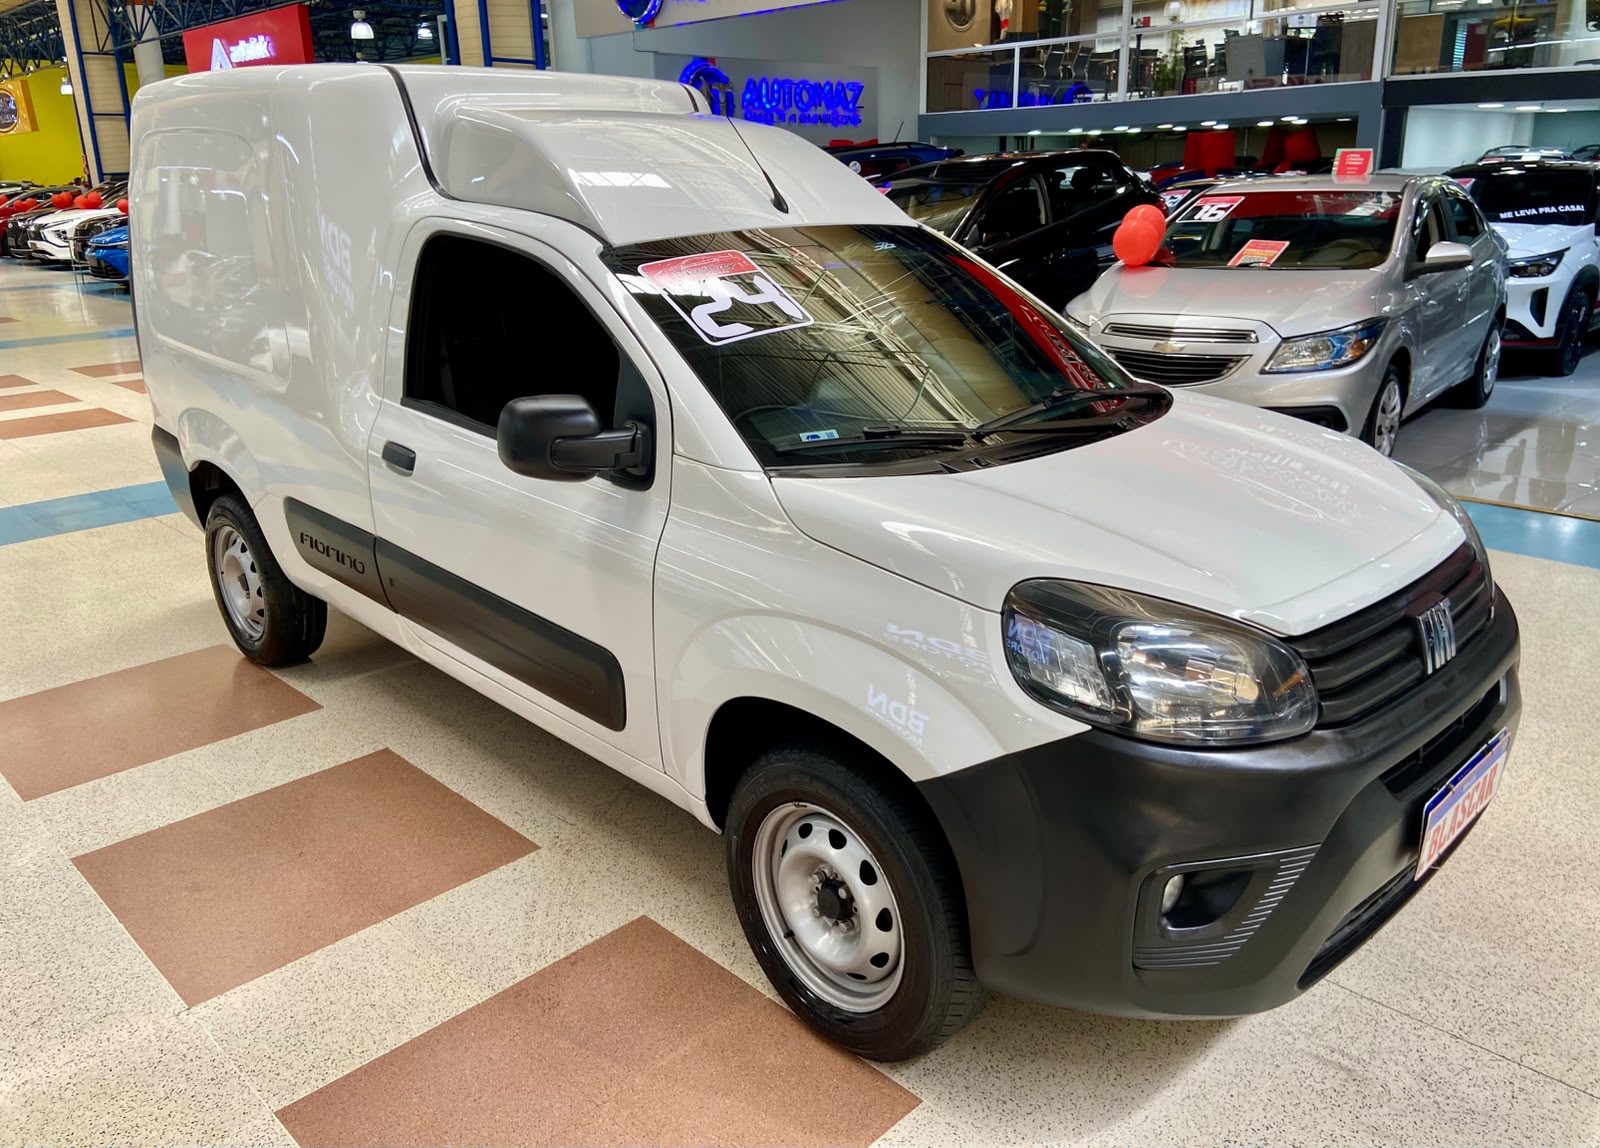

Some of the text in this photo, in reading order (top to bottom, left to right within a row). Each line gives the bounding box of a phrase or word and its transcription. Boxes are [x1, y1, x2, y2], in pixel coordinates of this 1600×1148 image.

[742, 77, 864, 112] AUTOMAZ
[1193, 204, 1231, 220] 16
[1515, 208, 1537, 217] LEVA
[1538, 206, 1555, 214] PRA
[1558, 204, 1585, 212] CASA!
[690, 275, 804, 338] 24
[1427, 764, 1498, 863] BLASCAR
